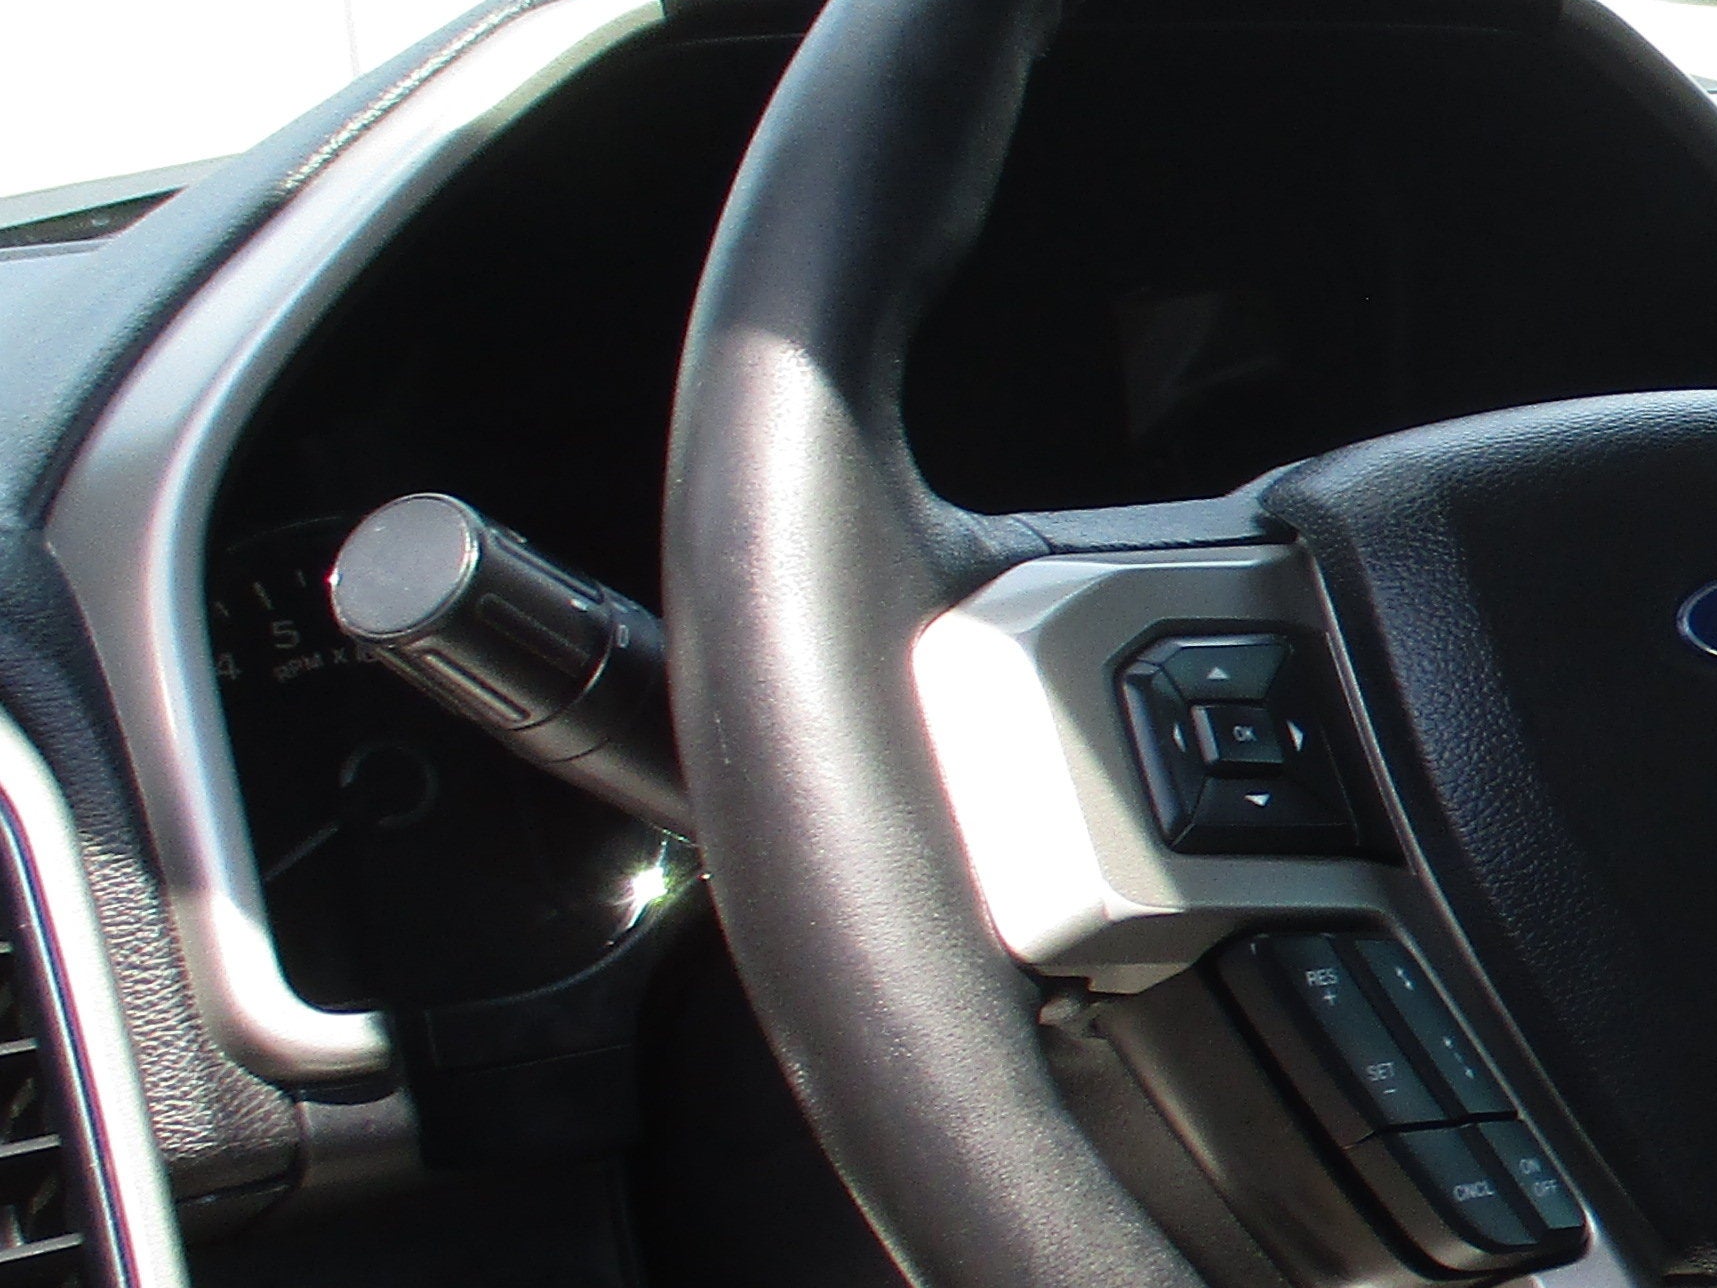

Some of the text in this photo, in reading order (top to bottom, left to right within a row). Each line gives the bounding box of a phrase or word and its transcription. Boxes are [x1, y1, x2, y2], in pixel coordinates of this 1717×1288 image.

[269, 618, 301, 650] 5
[216, 651, 243, 682] 4
[273, 650, 325, 684] RPM
[1233, 725, 1258, 743] OK
[1305, 967, 1339, 986] RES
[1365, 1062, 1396, 1082] SET
[1519, 1158, 1541, 1175] ON
[1453, 1181, 1496, 1201] CNCL
[1532, 1179, 1558, 1198] OFF
